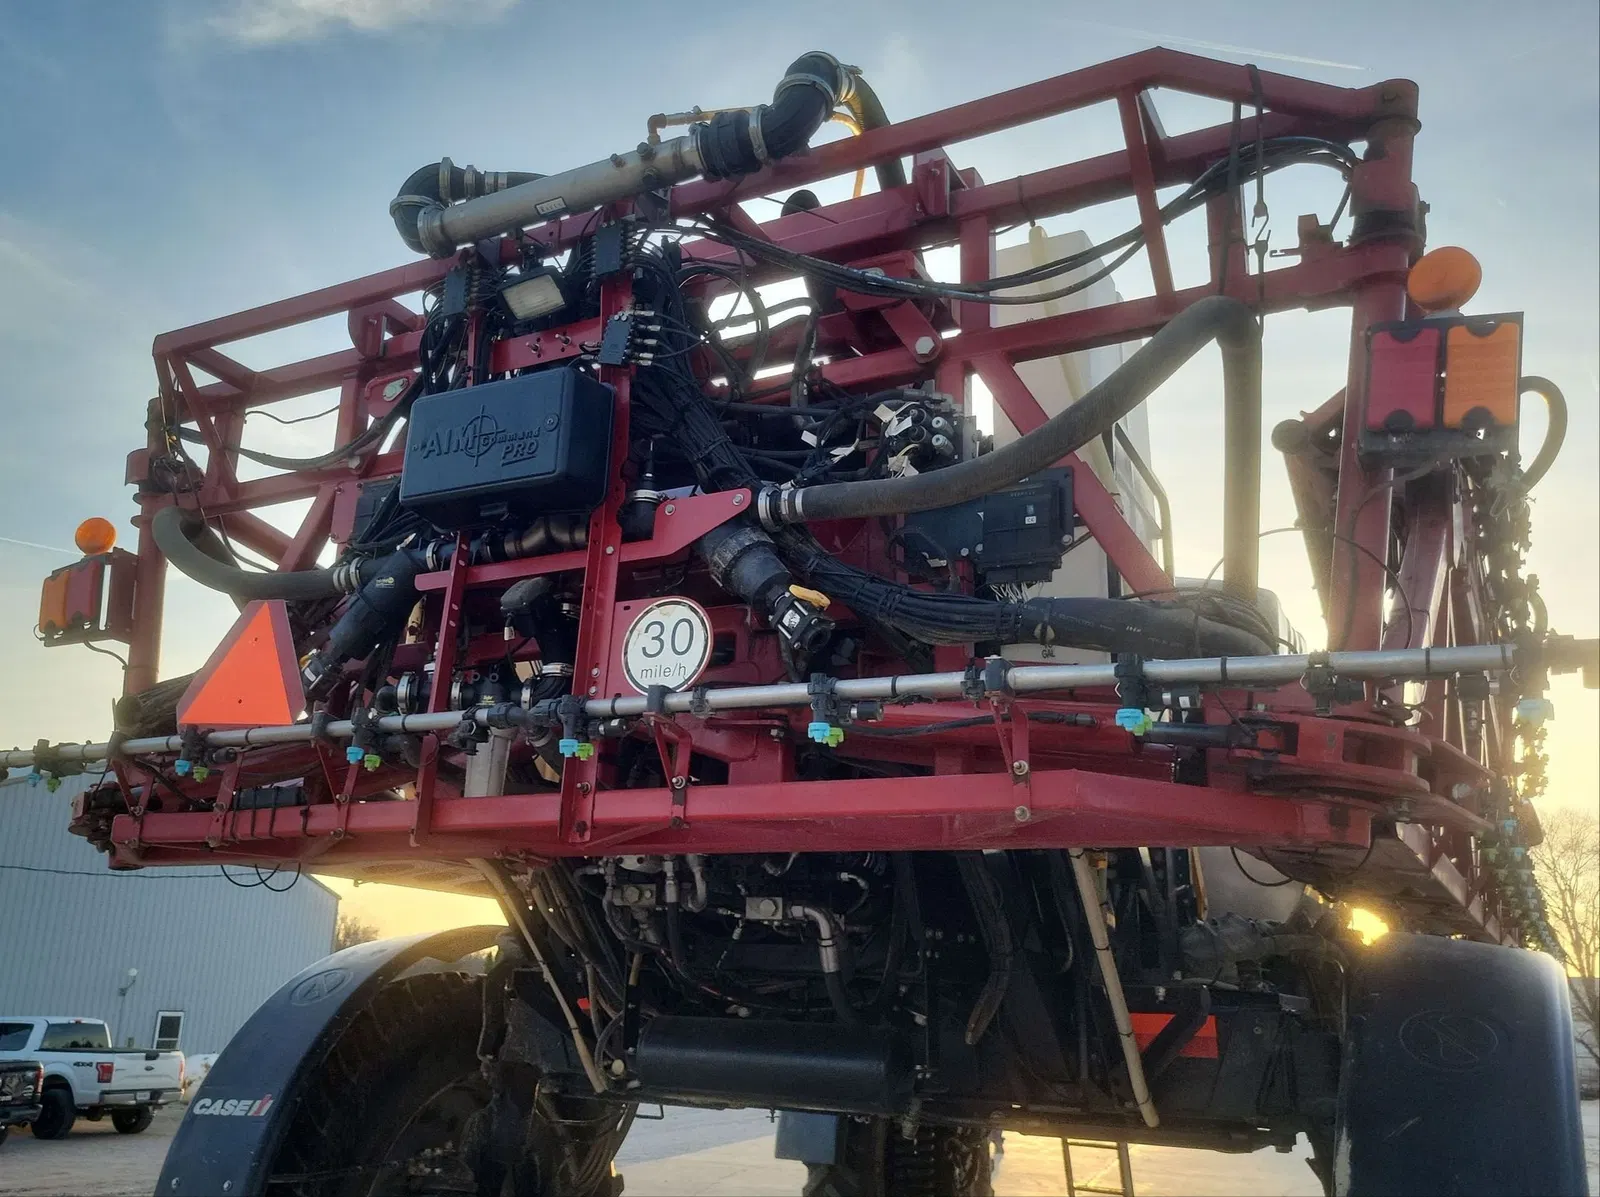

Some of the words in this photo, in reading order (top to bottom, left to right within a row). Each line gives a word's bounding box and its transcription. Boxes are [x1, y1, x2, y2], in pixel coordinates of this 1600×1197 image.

[501, 440, 539, 461] PRO
[641, 617, 695, 659] 30
[640, 662, 687, 679] mile/h
